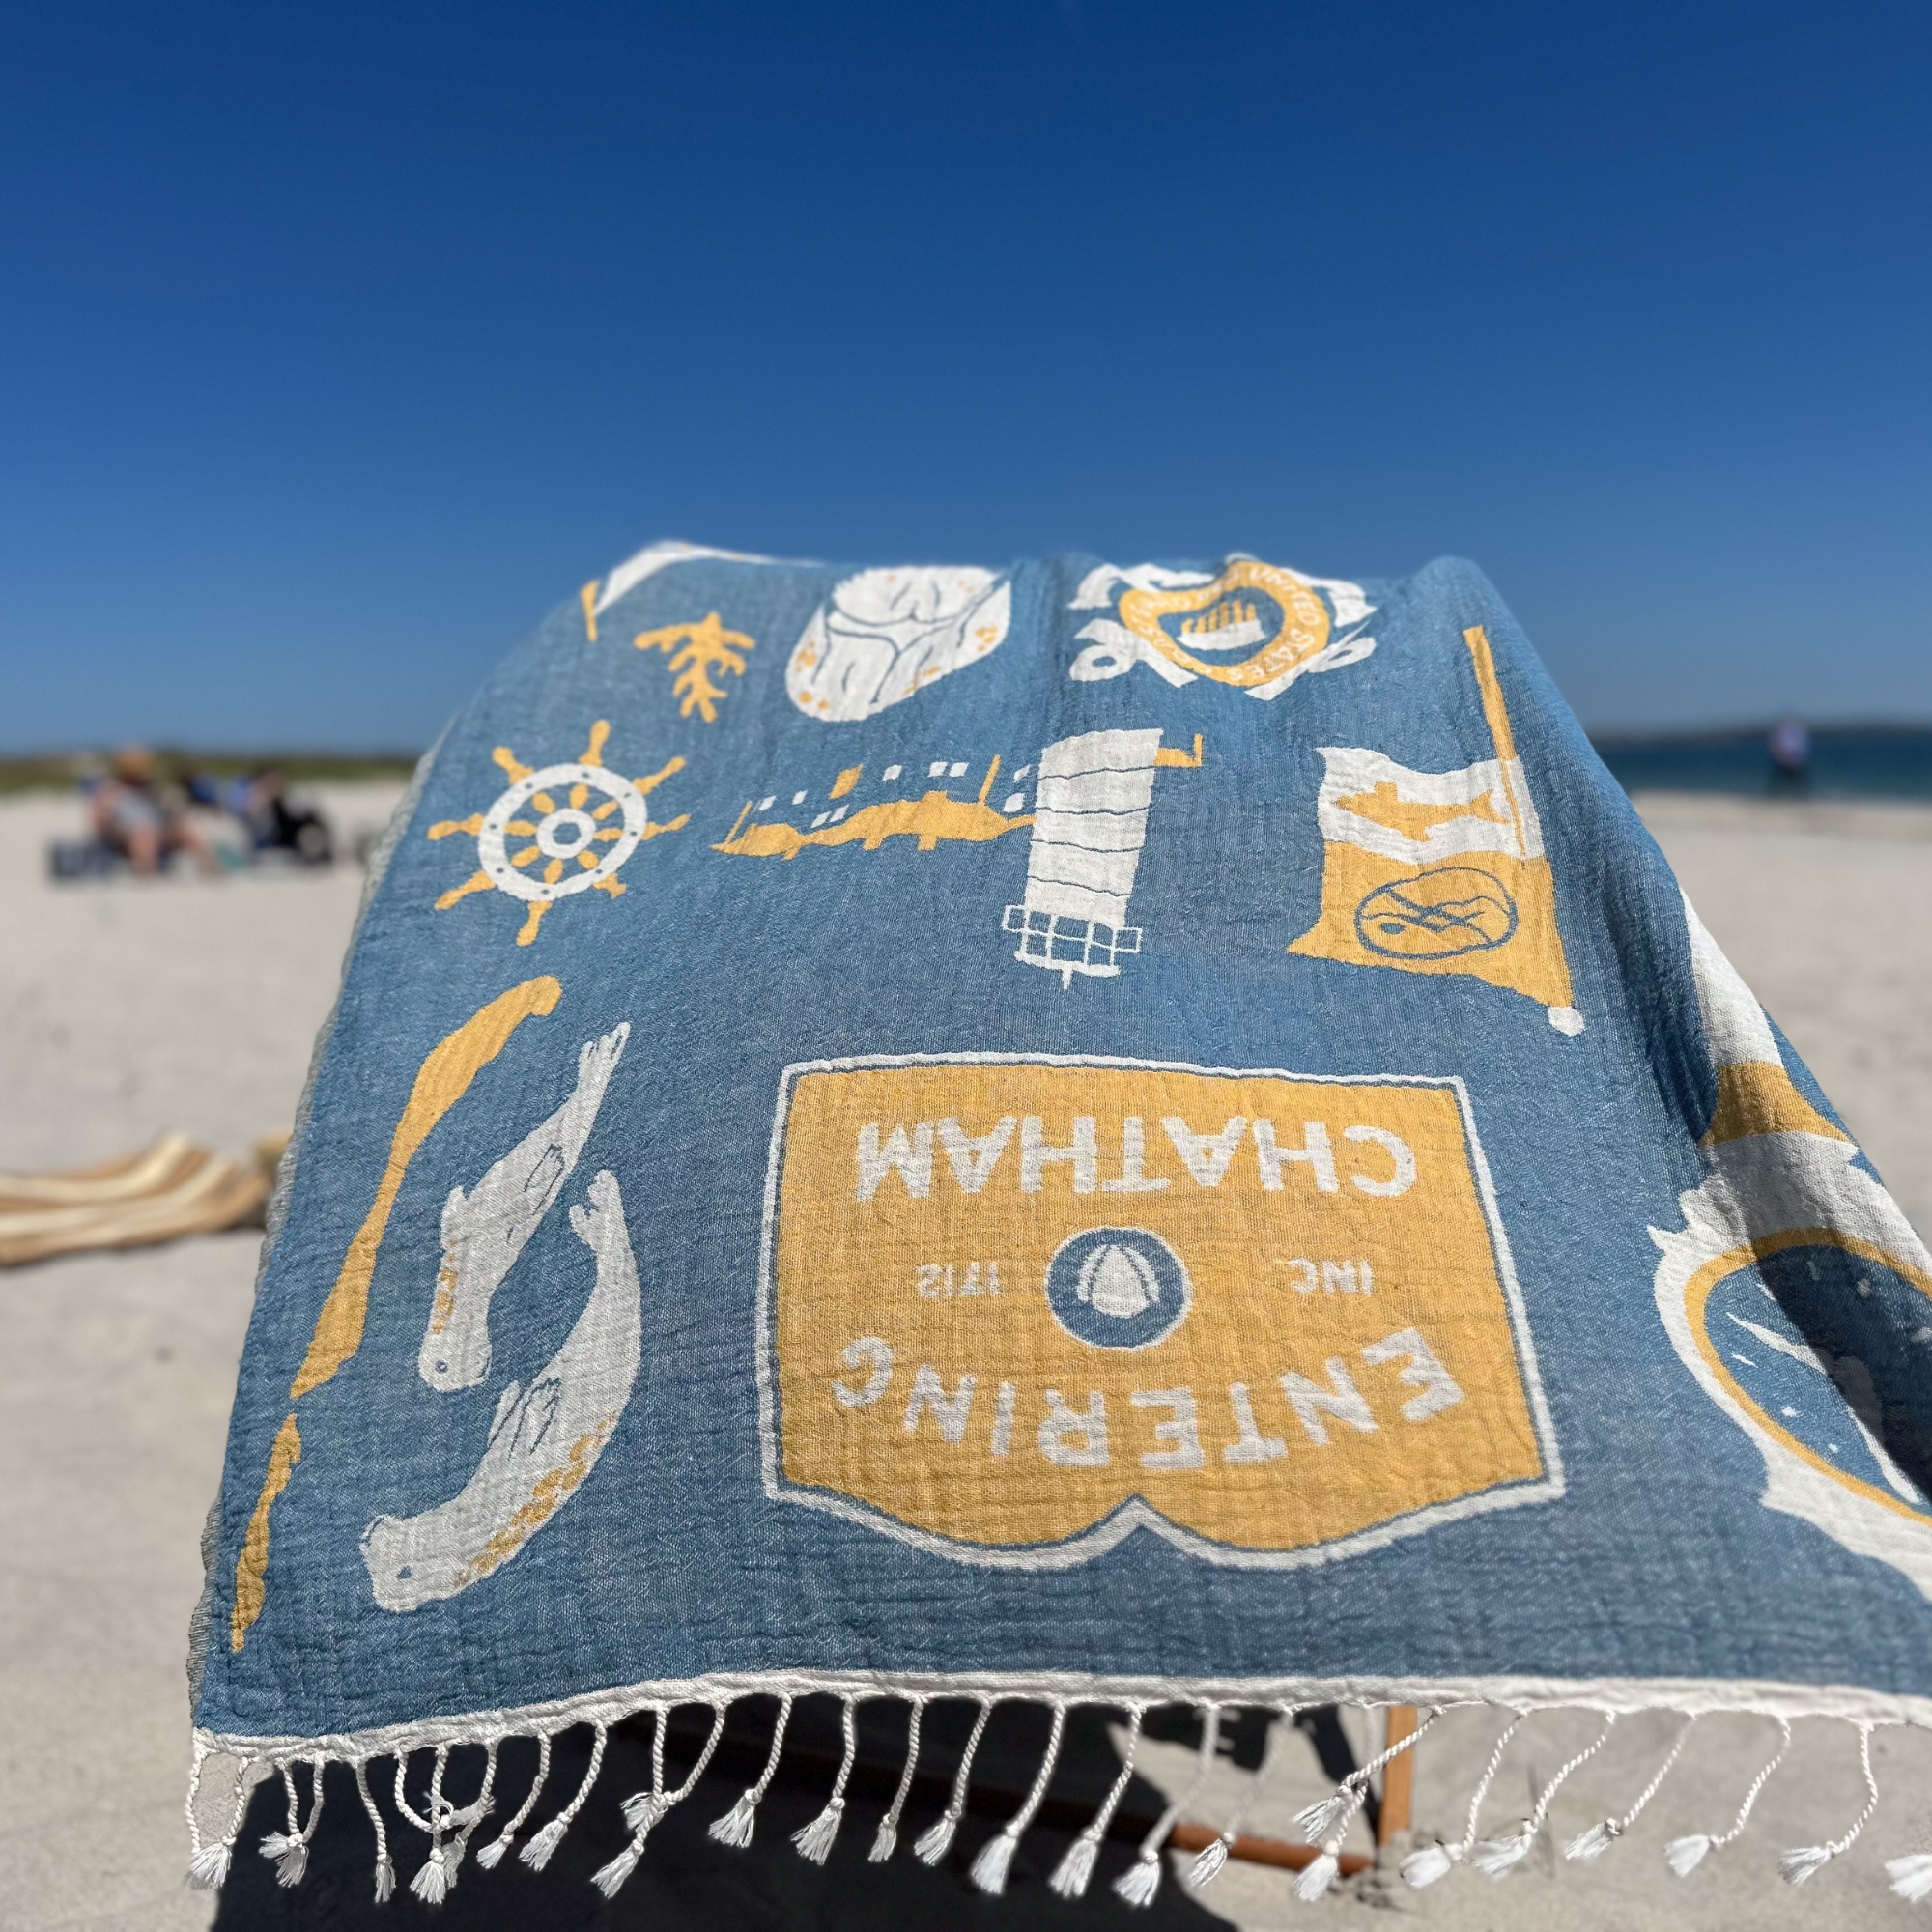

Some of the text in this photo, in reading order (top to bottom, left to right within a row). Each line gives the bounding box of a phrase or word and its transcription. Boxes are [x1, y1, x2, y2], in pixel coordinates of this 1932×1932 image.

[1226, 628, 1316, 681] STATES
[857, 1116, 1416, 1201] CHATHAM
[917, 1258, 1373, 1298] INC 1712
[831, 1326, 1465, 1469] ENTERING
